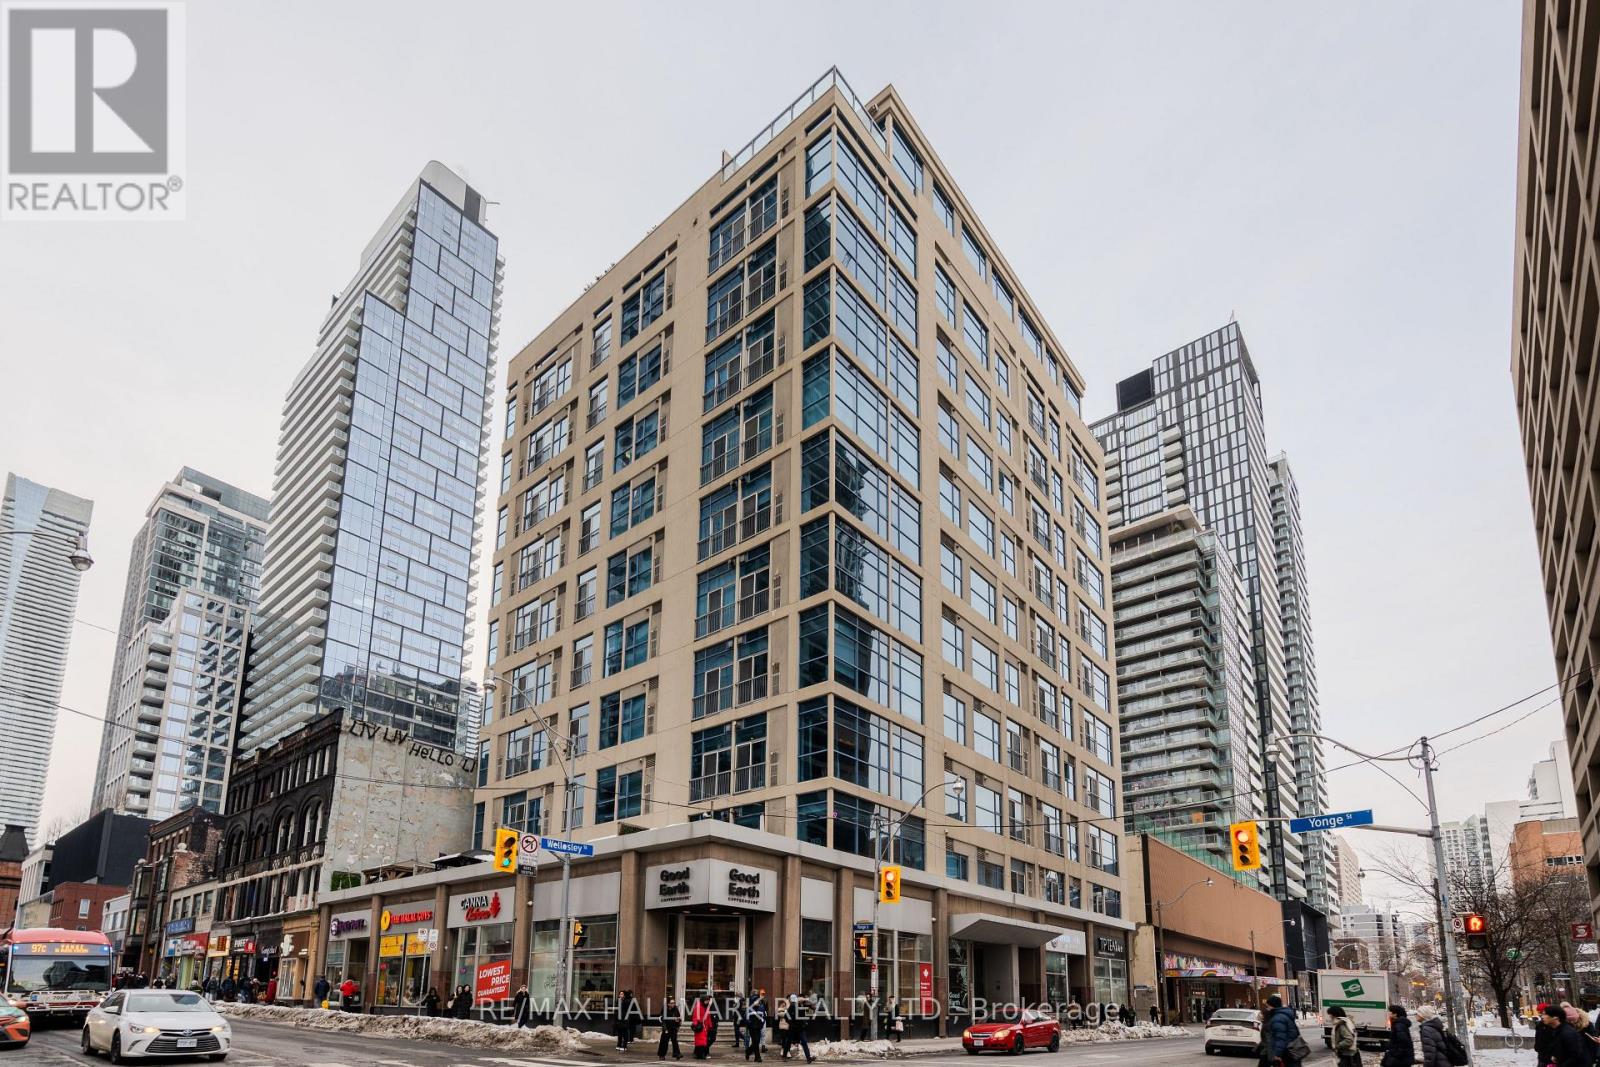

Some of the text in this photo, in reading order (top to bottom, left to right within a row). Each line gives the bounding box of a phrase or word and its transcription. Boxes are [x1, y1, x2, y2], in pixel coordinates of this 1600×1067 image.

[1308, 815, 1344, 828] Yonge
[660, 866, 691, 883] Good
[728, 868, 760, 885] Good
[659, 881, 691, 896] Earth
[728, 882, 760, 899] Earth
[460, 895, 489, 911] CANNA
[390, 910, 433, 925] THE HALAL GUYS
[31, 943, 47, 953] 97C
[478, 965, 505, 980] LOWEST
[490, 974, 511, 987] PRICE
